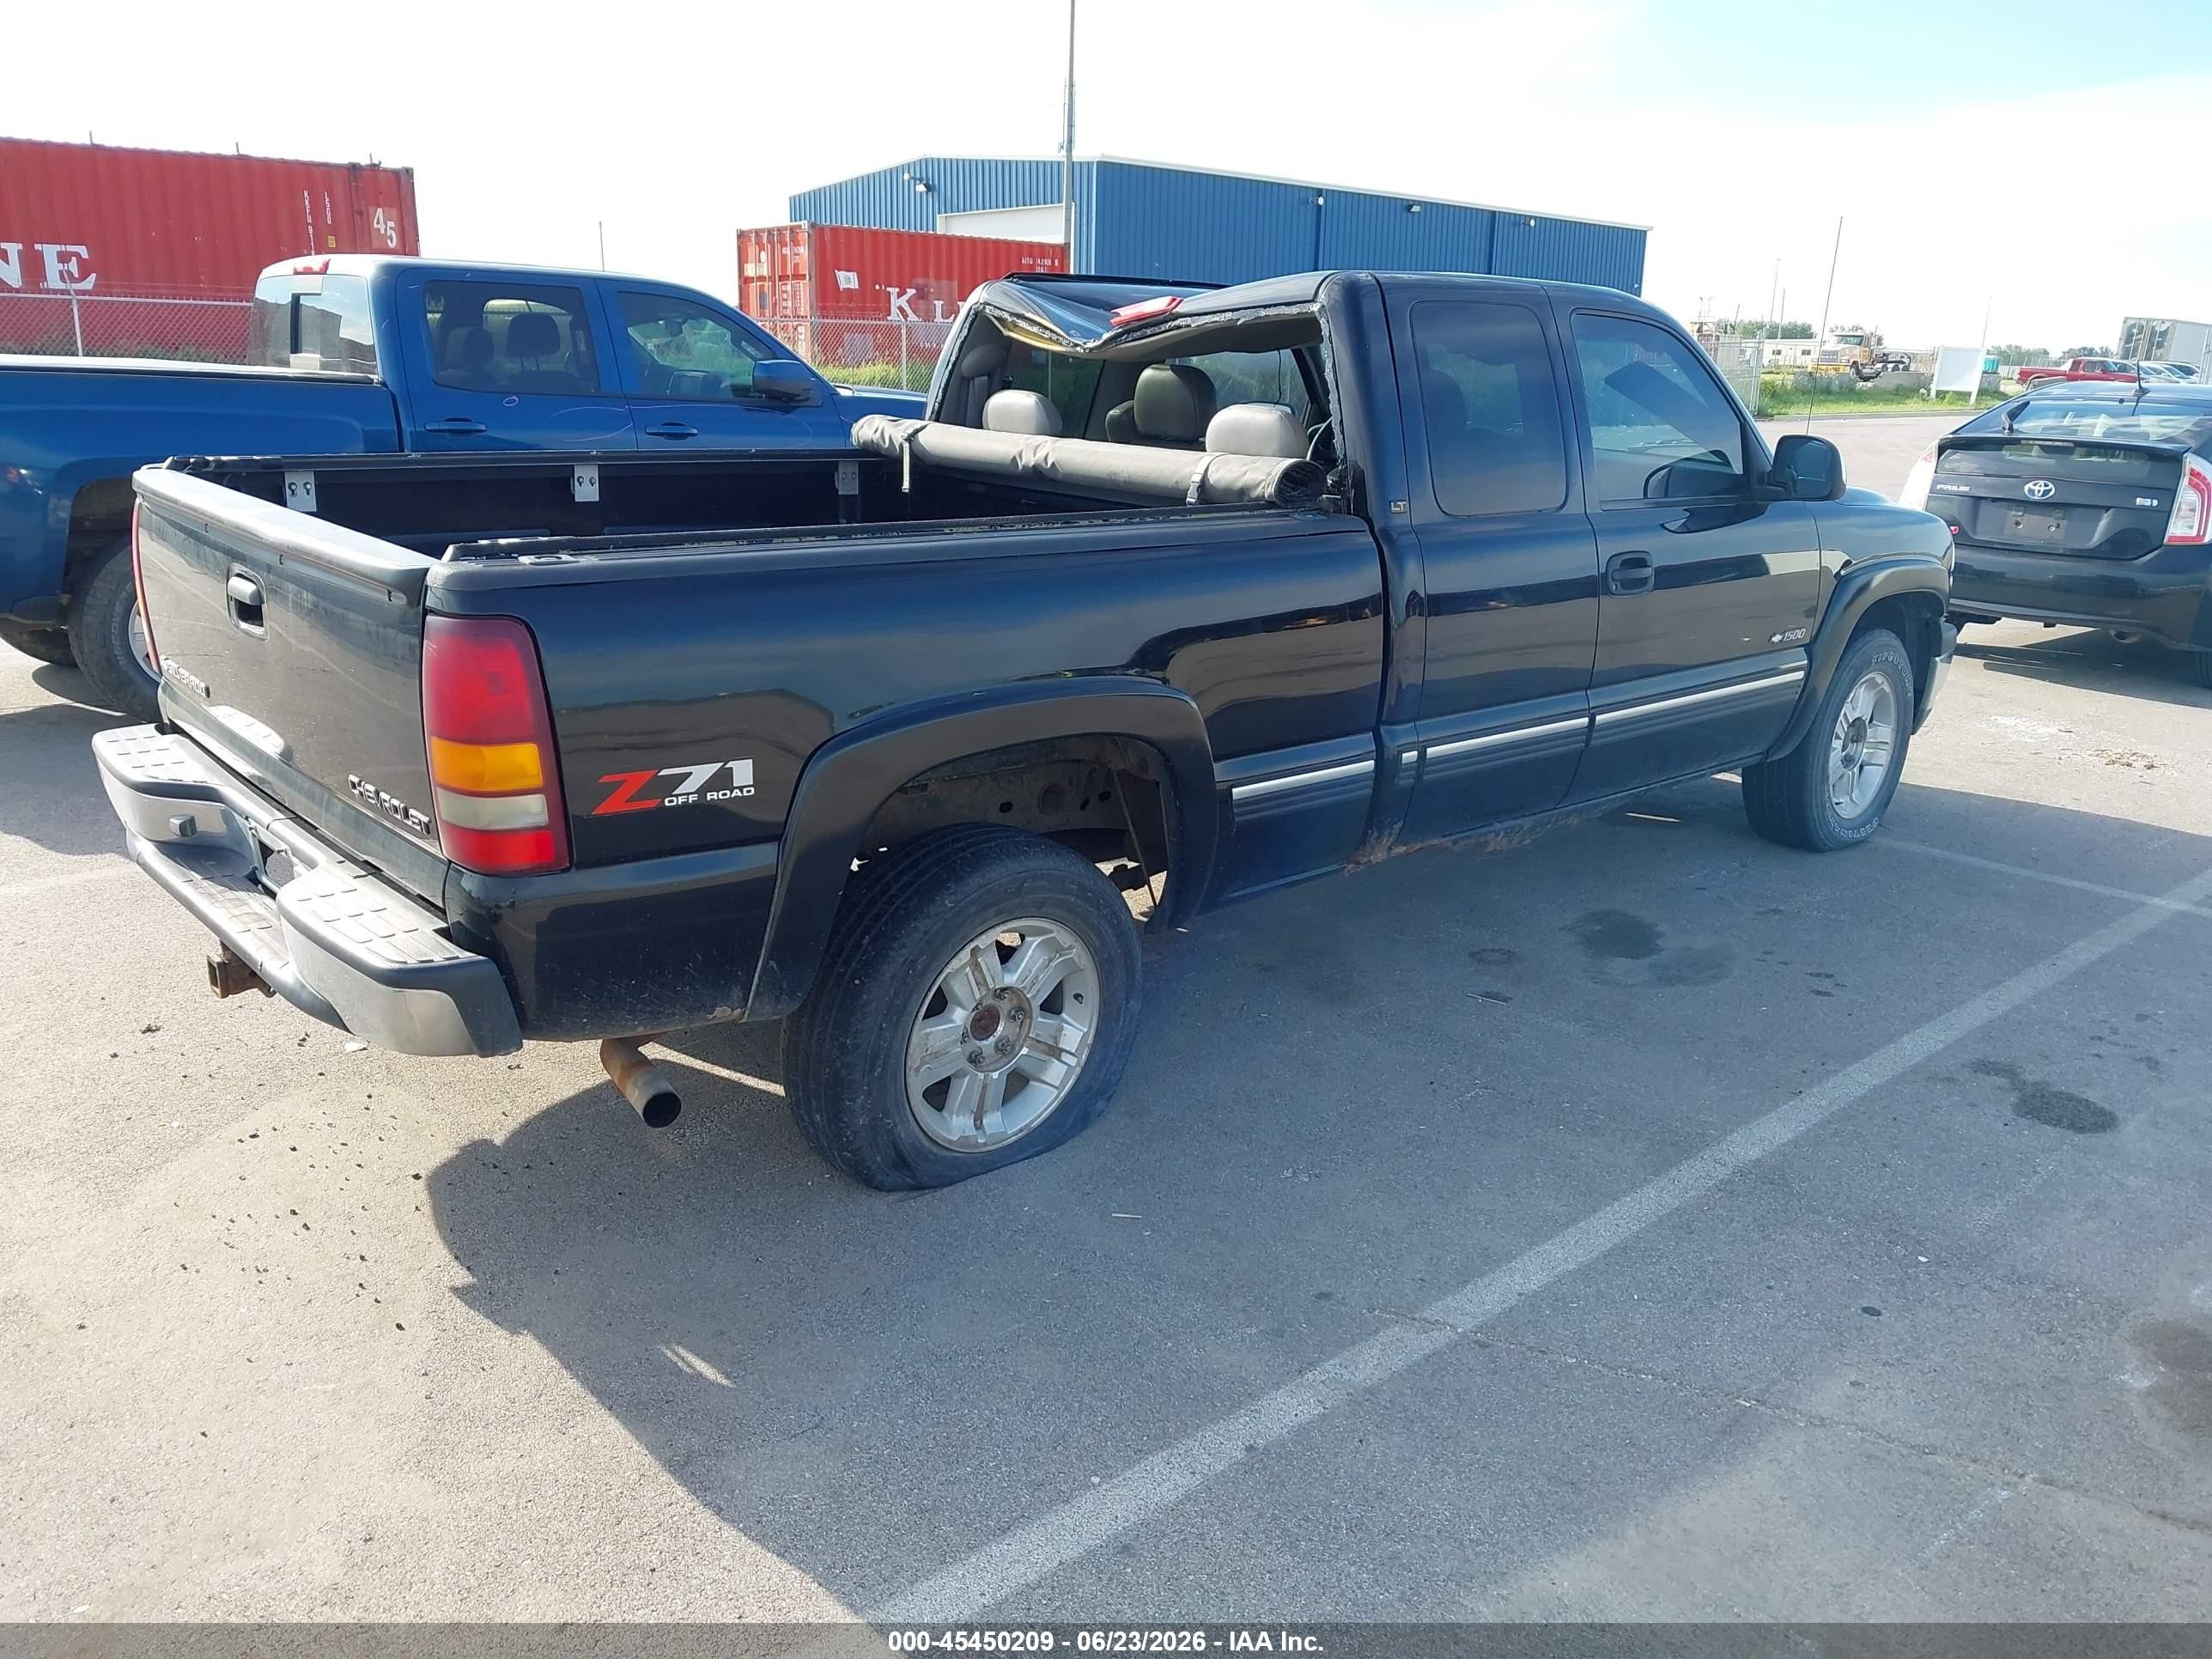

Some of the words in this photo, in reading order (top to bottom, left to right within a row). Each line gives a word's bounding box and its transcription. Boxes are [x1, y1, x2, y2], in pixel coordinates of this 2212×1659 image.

[373, 207, 398, 248] 45
[1390, 501, 1407, 513] LT
[1784, 628, 1807, 641] 1500
[592, 758, 754, 815] Z71
[664, 793, 699, 807] OFF
[706, 786, 756, 802] ROAD
[348, 774, 431, 836] CHEVROLET
